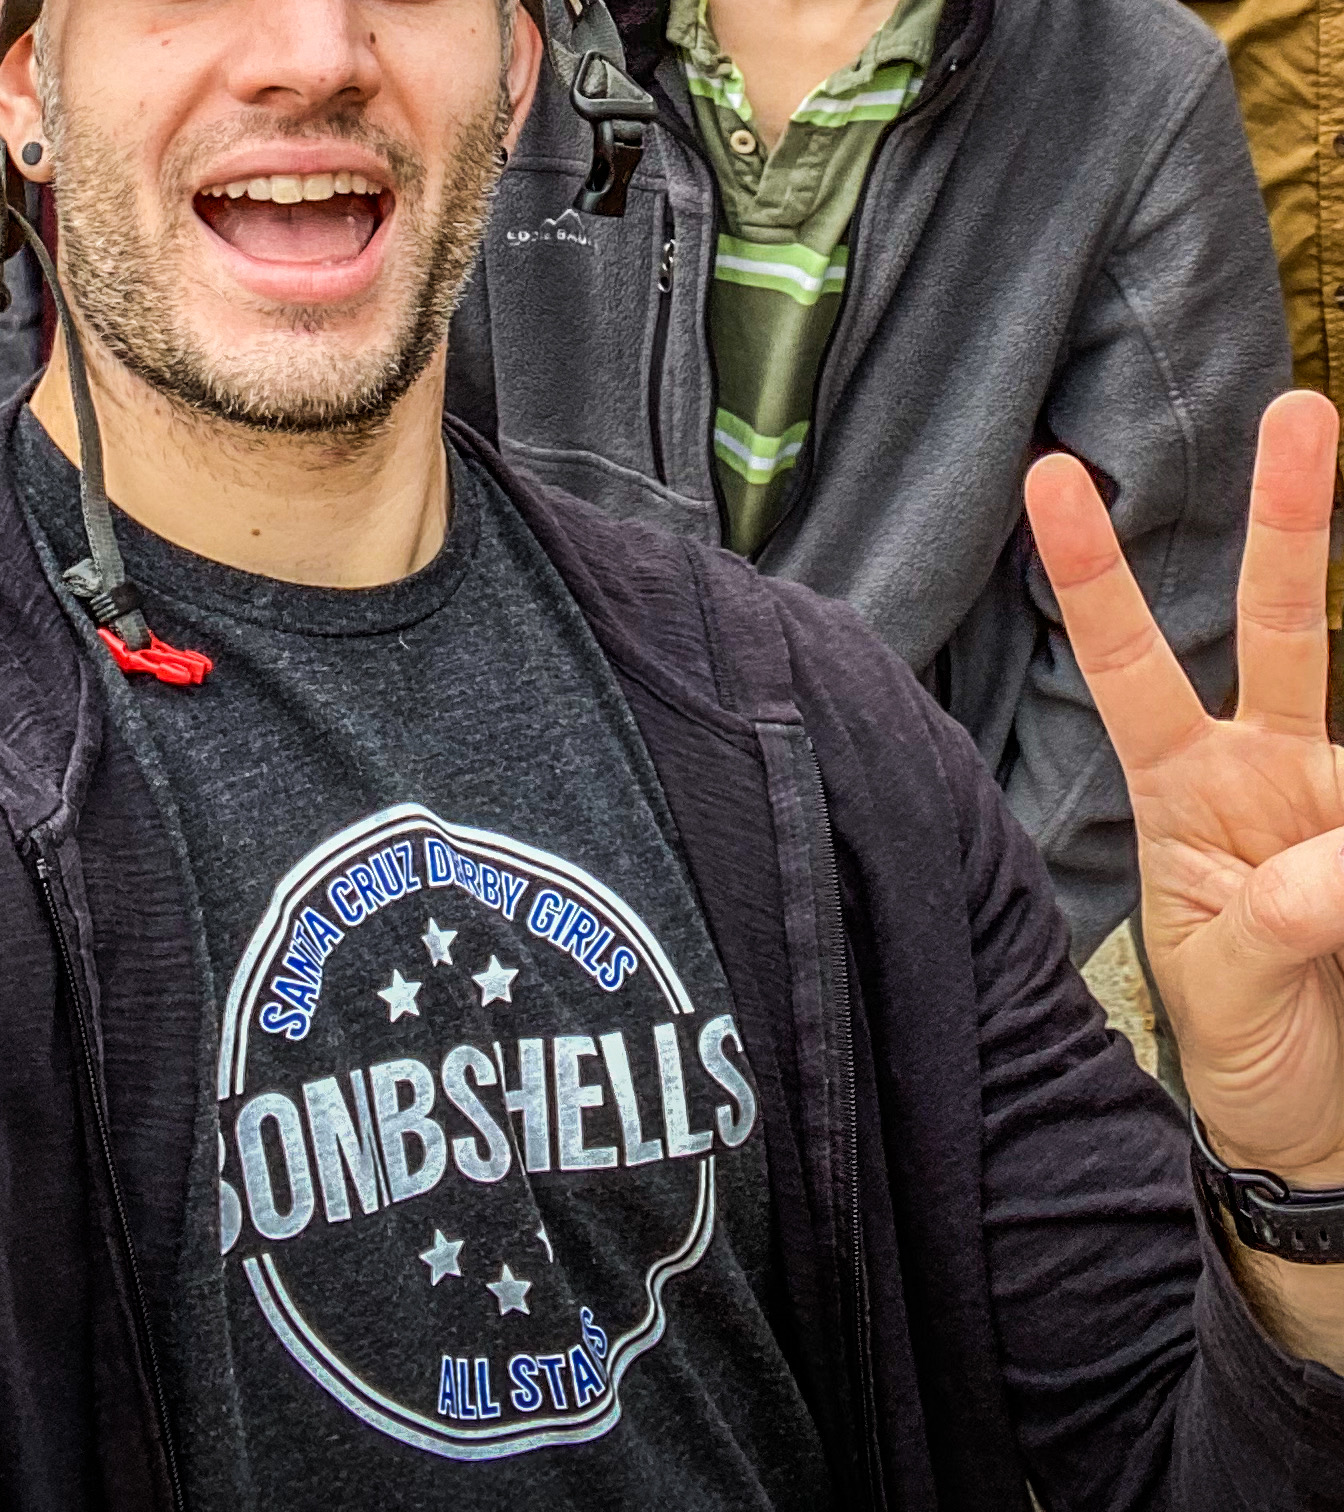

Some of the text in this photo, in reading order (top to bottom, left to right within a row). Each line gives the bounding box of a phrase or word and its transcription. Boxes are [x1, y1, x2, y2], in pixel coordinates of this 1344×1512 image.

[327, 840, 422, 927] CRUZ
[526, 889, 638, 992] GIRLS
[437, 1306, 608, 1420] ALL STAS
